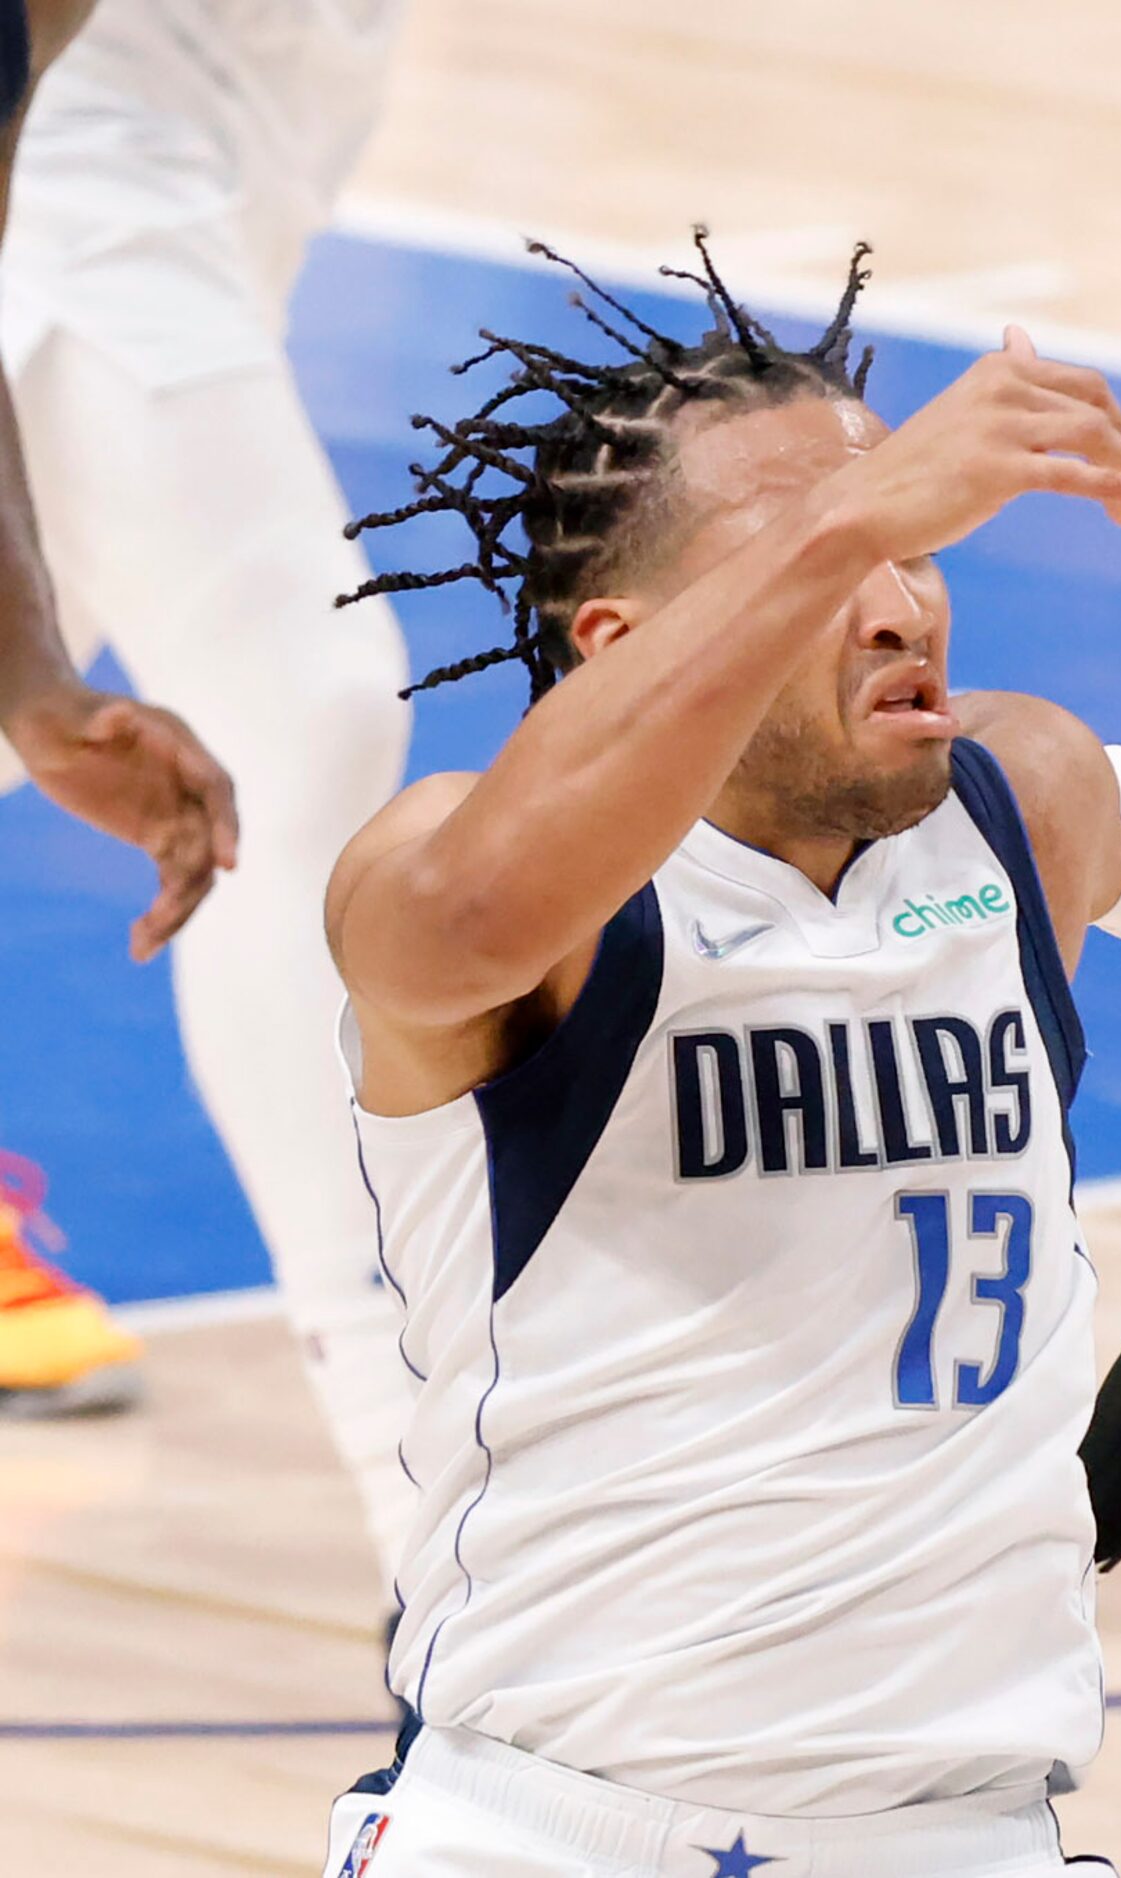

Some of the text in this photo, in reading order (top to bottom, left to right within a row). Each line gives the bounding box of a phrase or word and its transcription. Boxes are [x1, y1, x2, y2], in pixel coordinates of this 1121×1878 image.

[892, 883, 1010, 938] chime
[667, 1006, 1032, 1185] DALLAS
[891, 1188, 1035, 1412] 13
